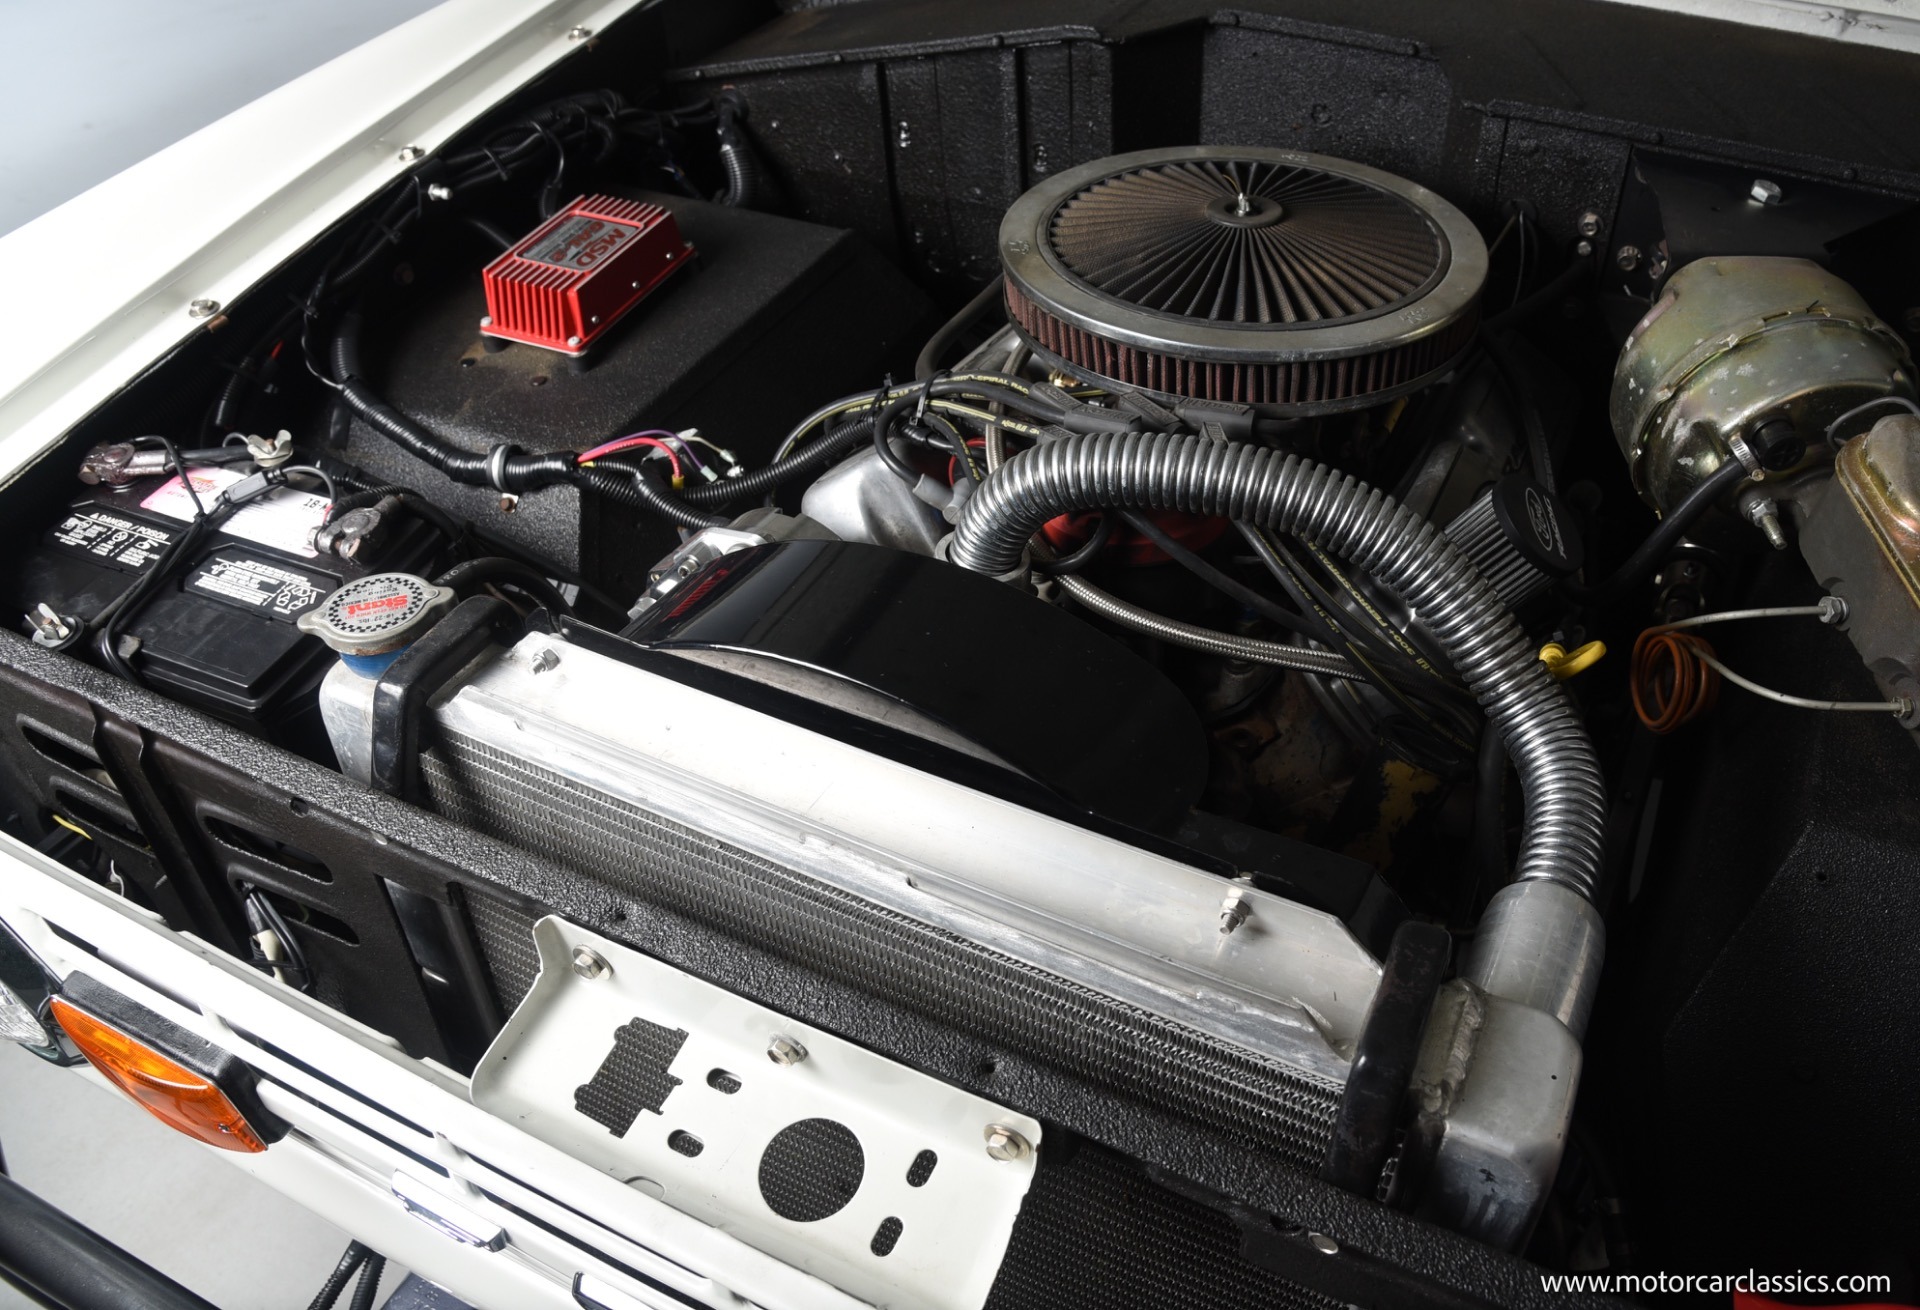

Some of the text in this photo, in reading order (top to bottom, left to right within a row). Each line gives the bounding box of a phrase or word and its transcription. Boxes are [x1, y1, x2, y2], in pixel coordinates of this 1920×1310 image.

[576, 228, 626, 267] MSD
[98, 514, 133, 530] DANGER
[136, 526, 170, 541] POISON
[348, 595, 408, 615] Stant
